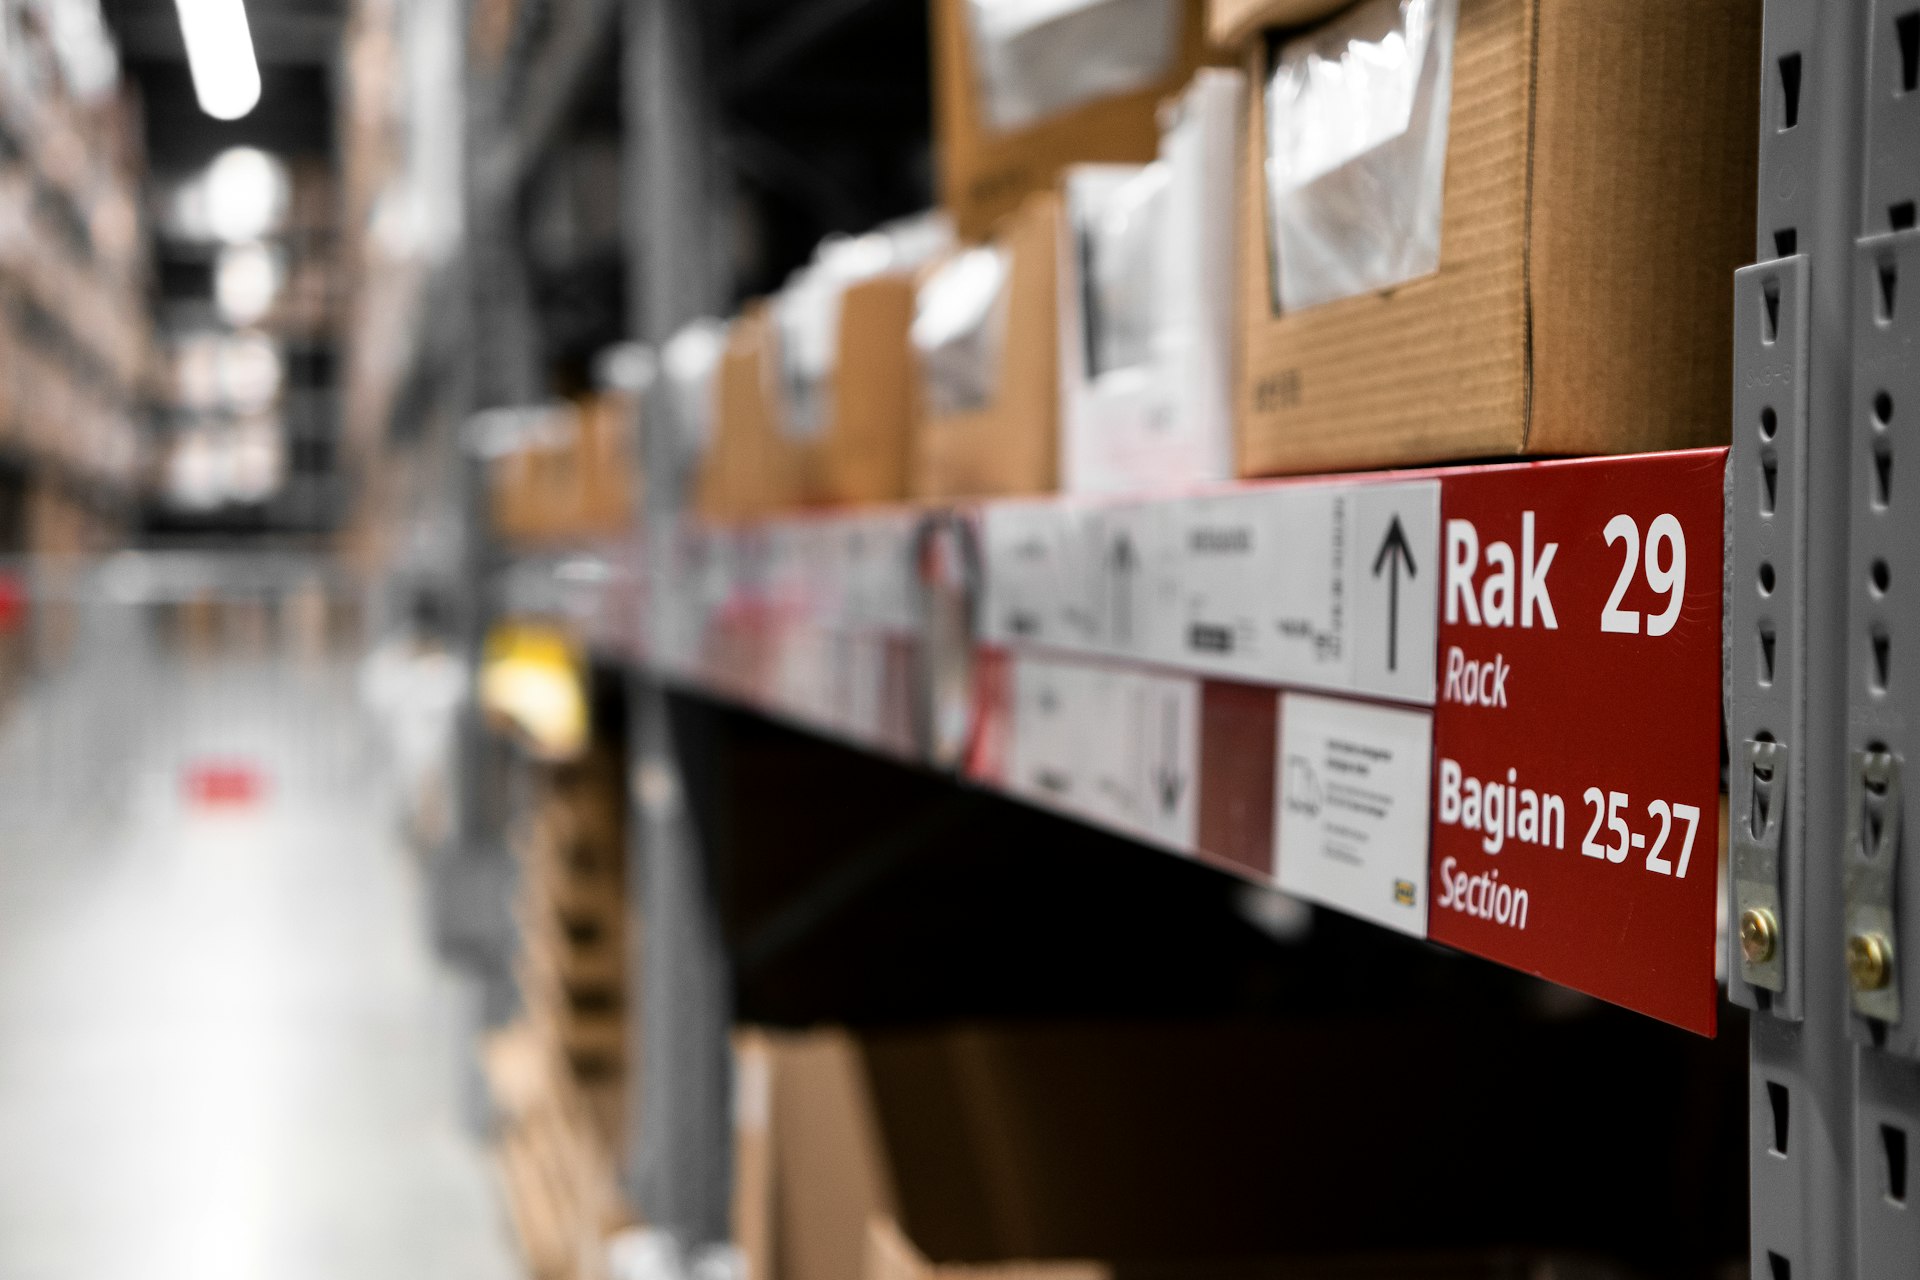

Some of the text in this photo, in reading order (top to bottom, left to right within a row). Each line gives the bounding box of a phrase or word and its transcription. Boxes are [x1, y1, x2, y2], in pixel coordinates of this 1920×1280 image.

[1446, 511, 1558, 629] Rak
[1601, 514, 1686, 636] 29
[1445, 647, 1509, 707] Rack
[1440, 759, 1700, 878] Bagian 25-27
[1438, 857, 1528, 929] Section
